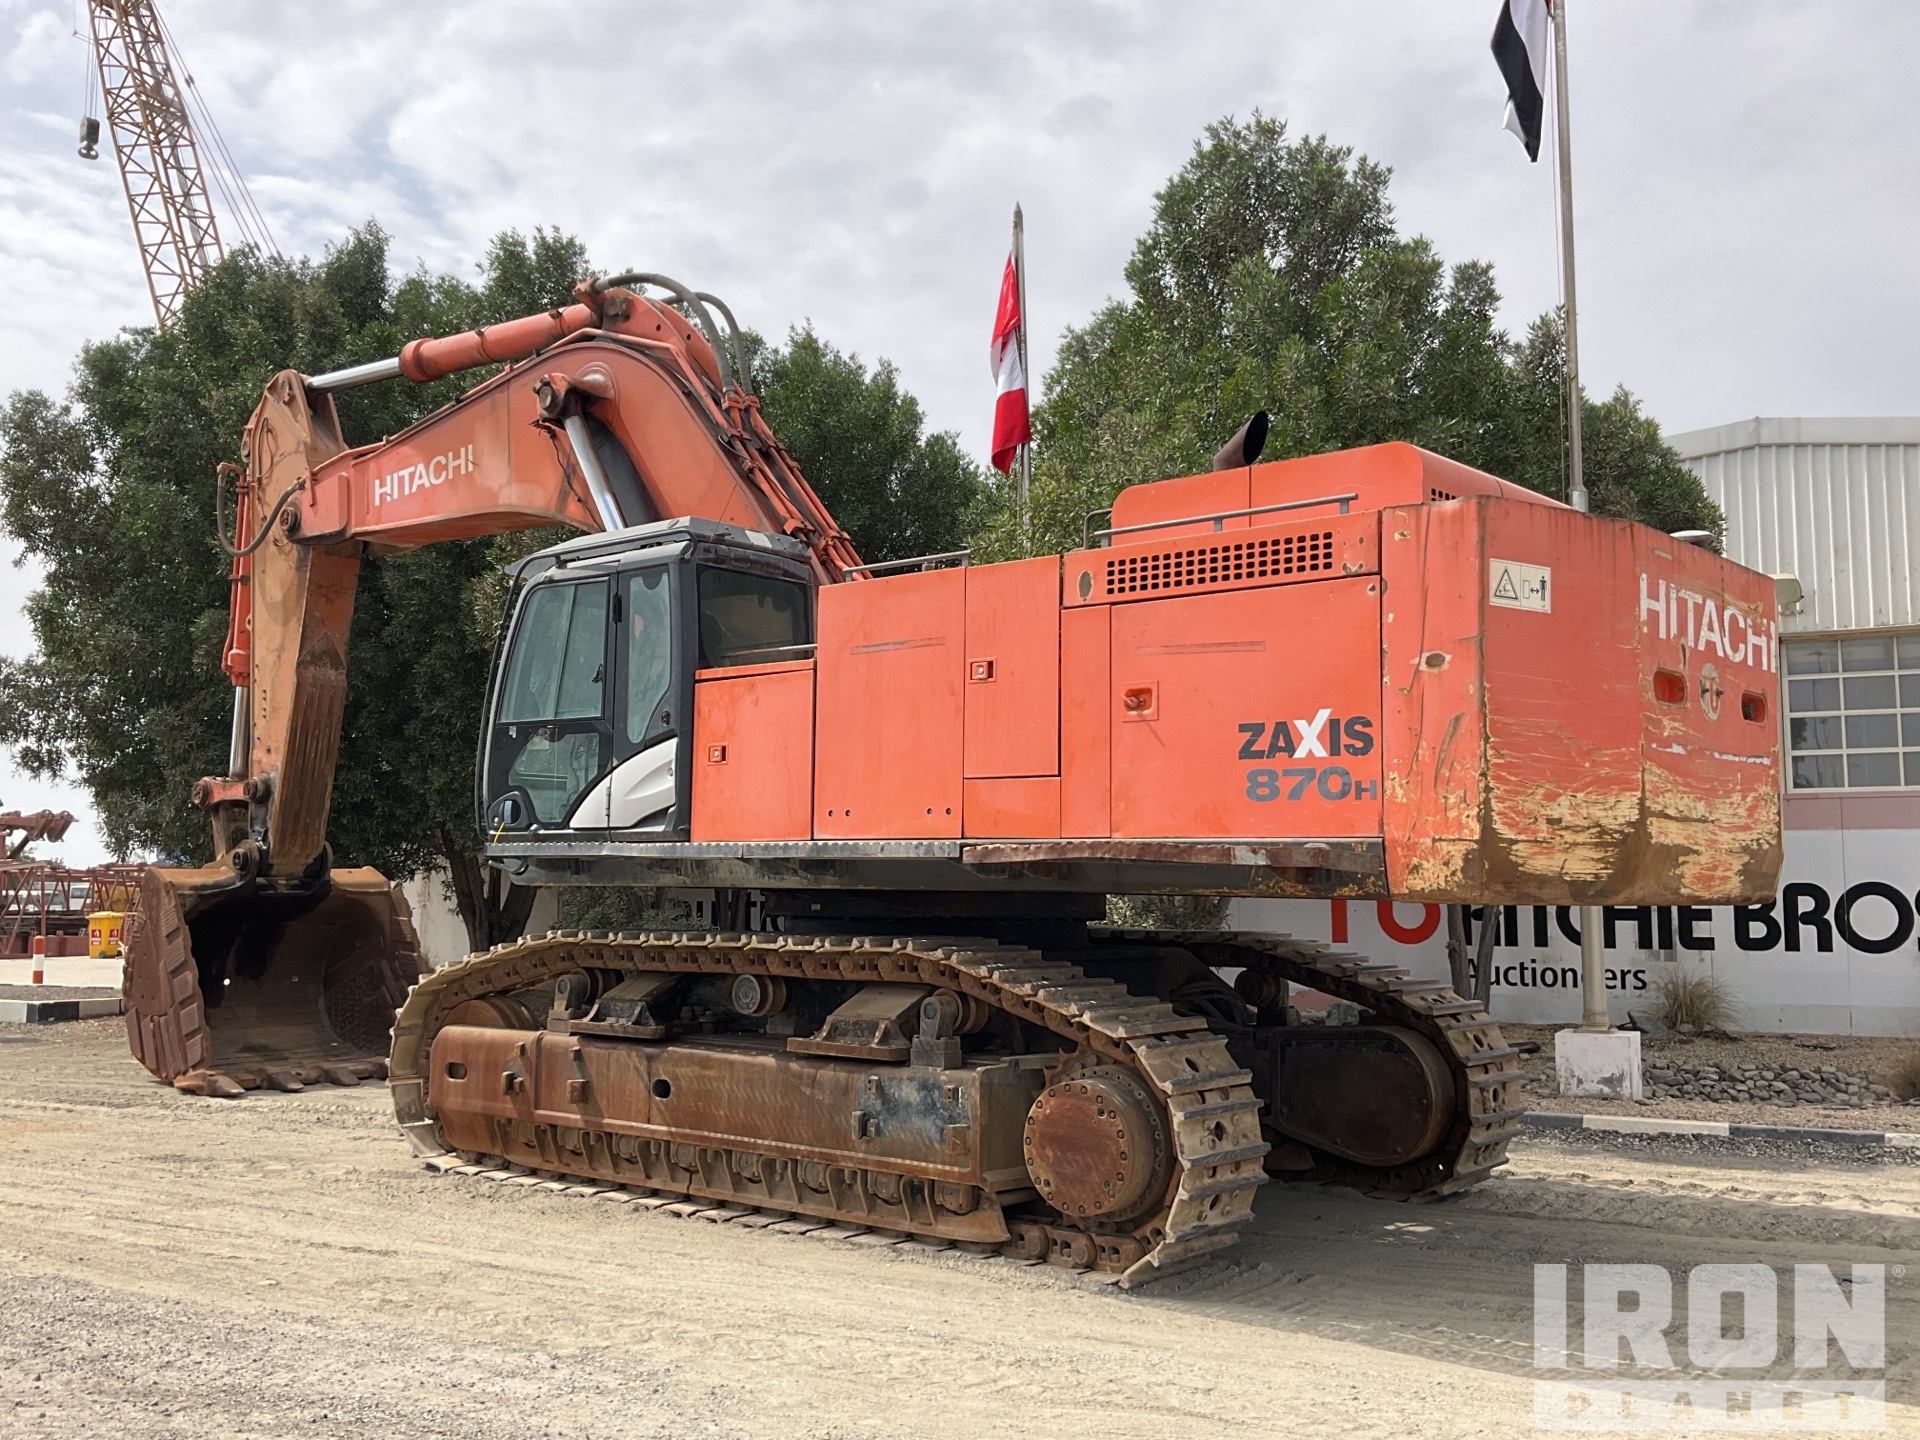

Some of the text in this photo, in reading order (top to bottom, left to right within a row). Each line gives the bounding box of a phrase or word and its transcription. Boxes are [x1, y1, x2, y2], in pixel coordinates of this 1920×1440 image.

[374, 444, 474, 507] HITACHI
[1639, 572, 1777, 674] HITACHI
[1237, 708, 1375, 760] ZAXIS
[1245, 765, 1378, 803] 870H
[1733, 881, 1920, 954] BRO
[1467, 957, 1648, 991] uctioners
